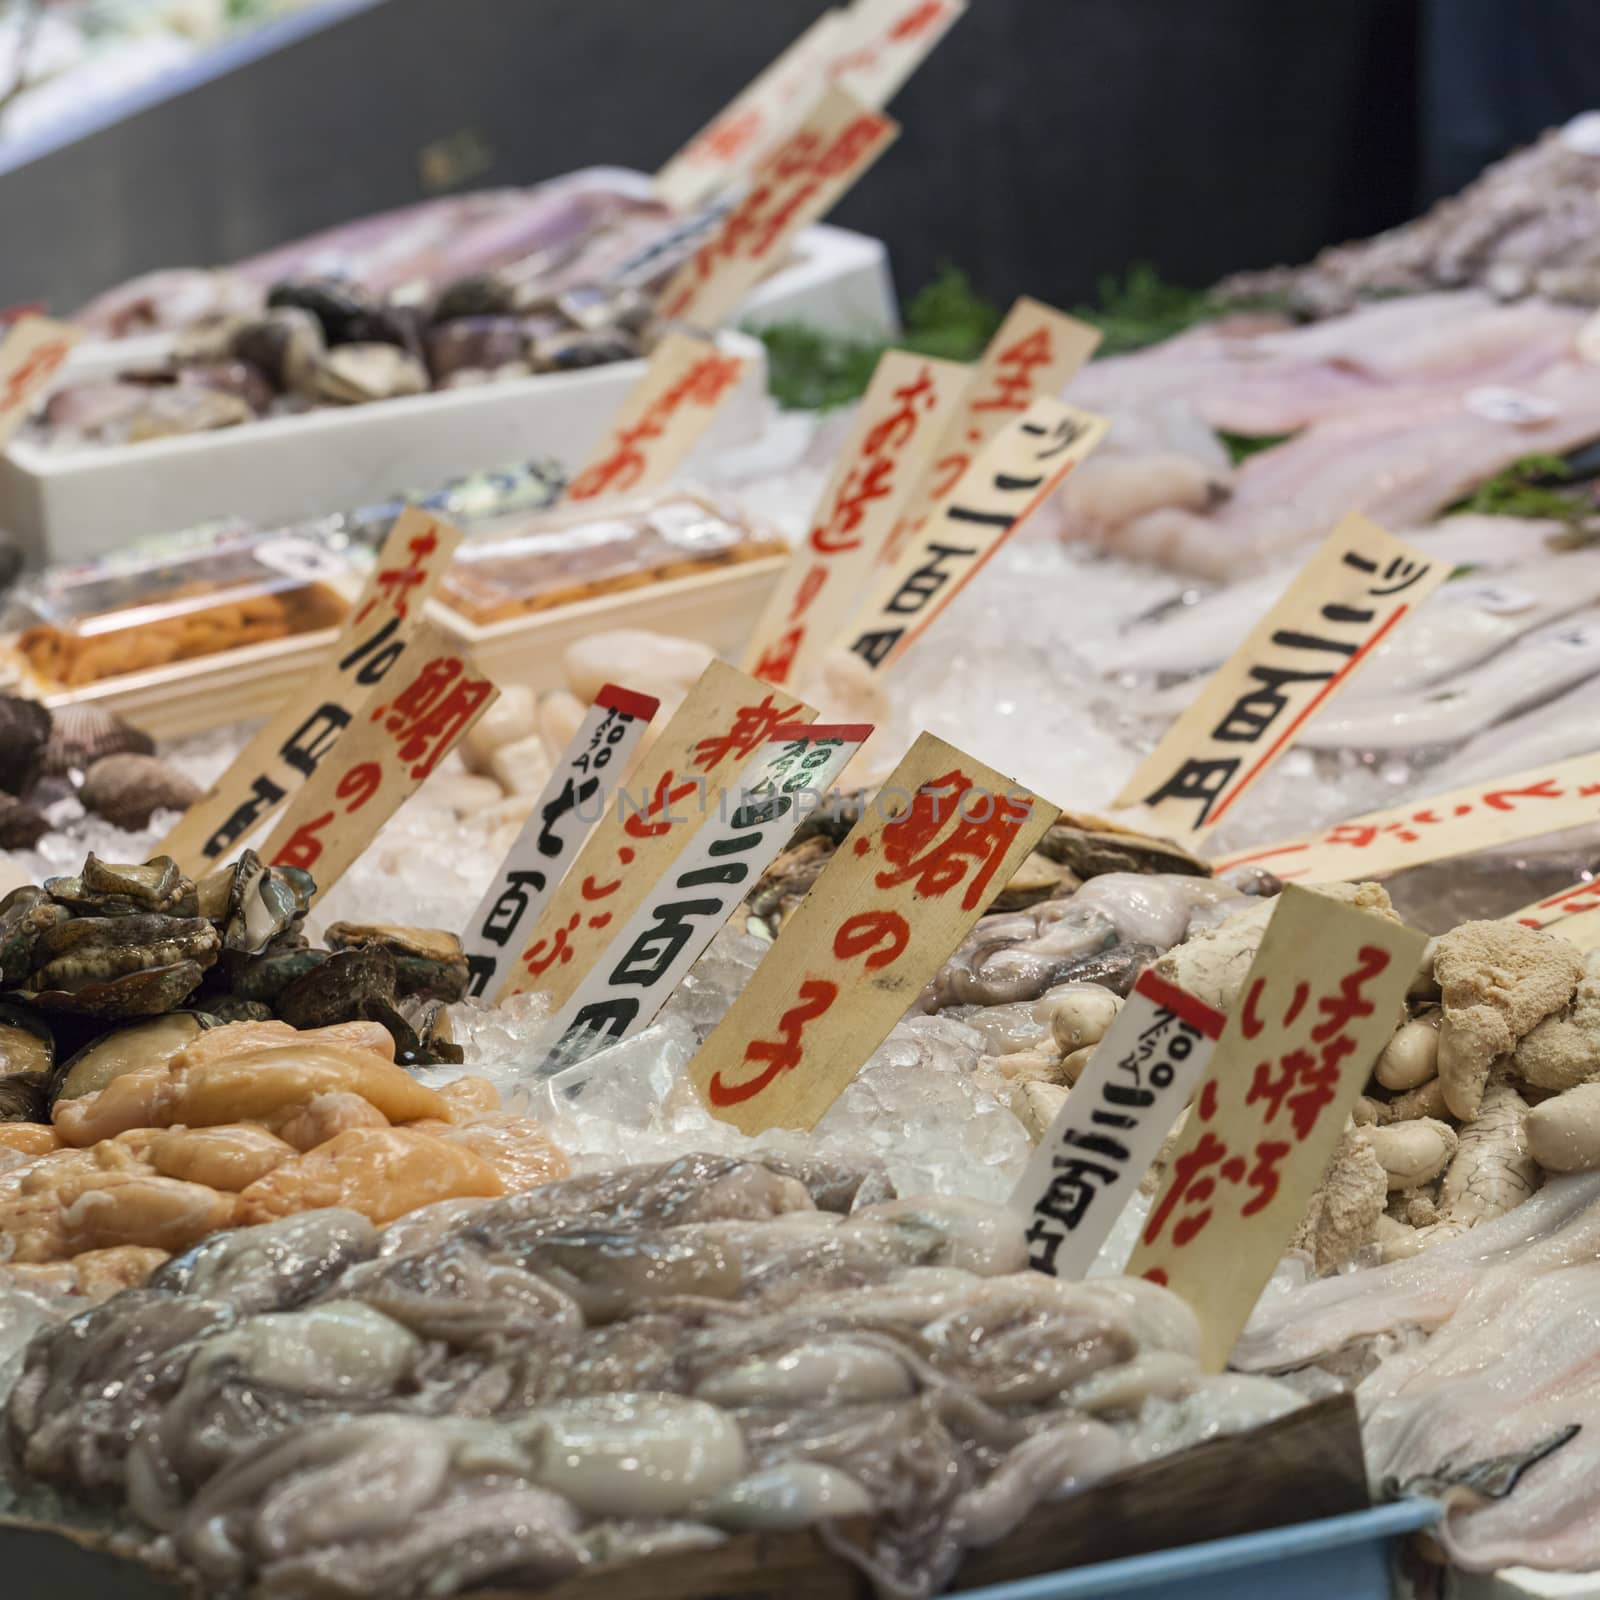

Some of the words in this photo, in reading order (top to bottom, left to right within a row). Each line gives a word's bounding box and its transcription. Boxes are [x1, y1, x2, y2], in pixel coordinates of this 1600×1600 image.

[510, 693, 806, 995] 新とこぶ
[708, 767, 1034, 1109] 鯛の子
[1140, 977, 1310, 1288] いいだ
